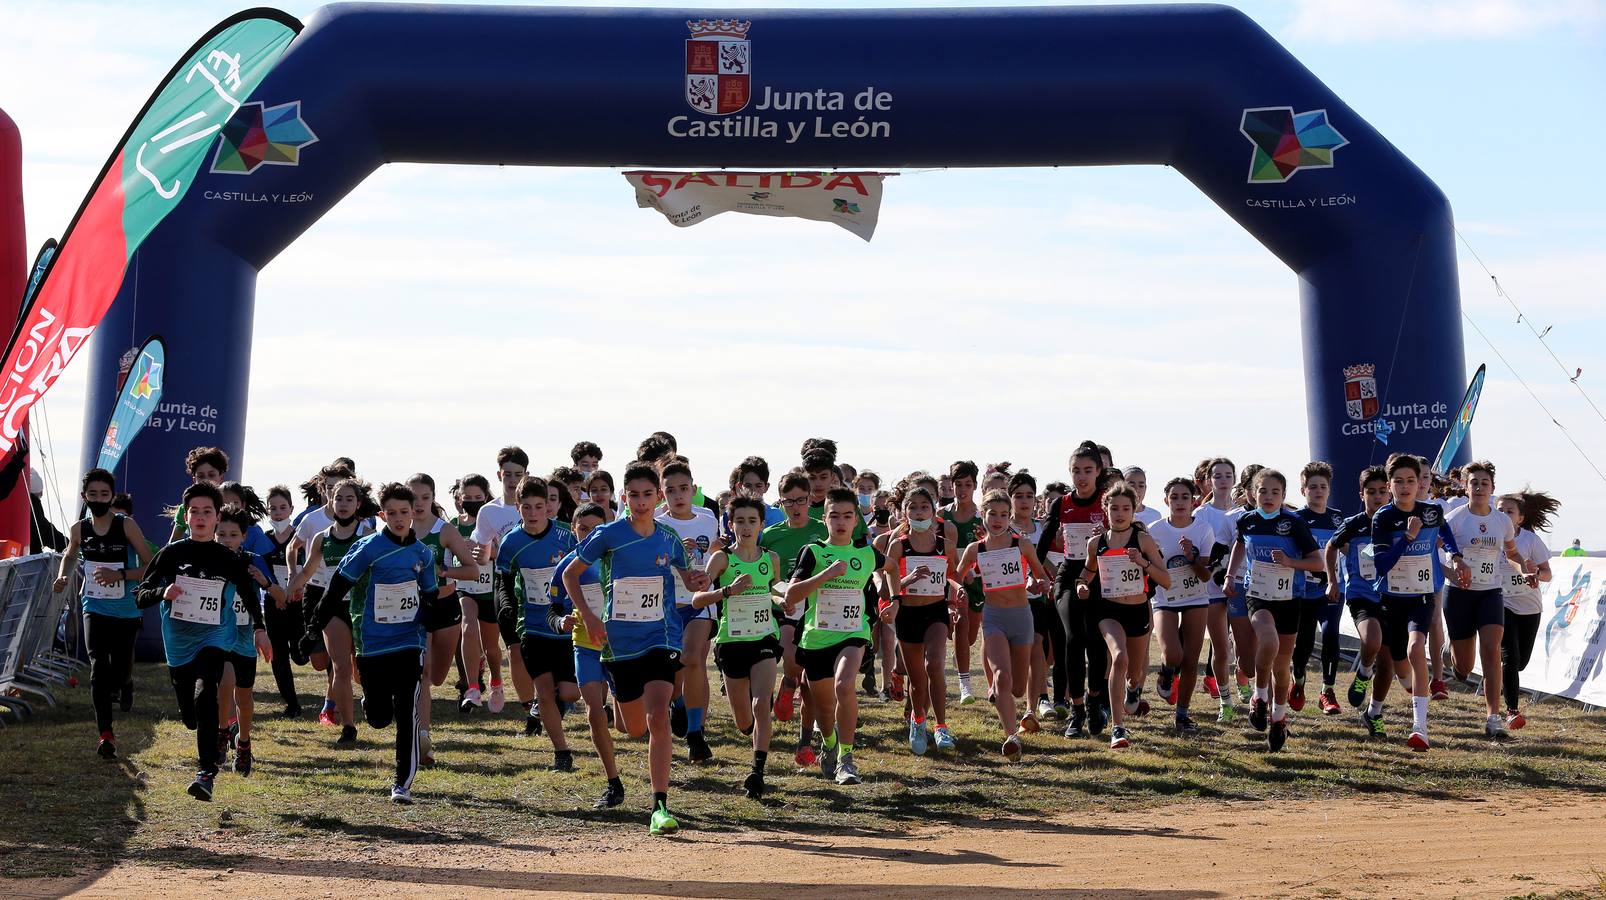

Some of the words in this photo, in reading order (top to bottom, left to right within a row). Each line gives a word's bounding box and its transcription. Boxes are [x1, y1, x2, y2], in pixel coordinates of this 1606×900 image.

[755, 86, 844, 111] Junta
[854, 86, 893, 111] de
[667, 115, 777, 138] Castilla
[785, 120, 806, 144] y
[815, 116, 891, 138] León
[204, 190, 272, 203] CASTILLA
[272, 193, 280, 202] Y
[281, 190, 314, 203] LEÓN
[1246, 198, 1306, 209] CASTILLA
[1308, 198, 1318, 207] Y
[1320, 193, 1356, 207] LEÓN
[200, 405, 218, 419] de
[1382, 402, 1427, 417] Junta
[1431, 401, 1448, 414] de
[165, 418, 176, 432] y
[180, 417, 216, 434] León
[1400, 421, 1410, 433] y
[1414, 416, 1448, 430] León
[1001, 561, 1020, 576] 364
[1120, 568, 1141, 583] 362
[1417, 568, 1430, 582] 96
[1480, 562, 1494, 574] 563
[930, 571, 945, 584] 361
[1182, 575, 1200, 590] 964
[1277, 578, 1290, 591] 91
[200, 596, 218, 611] 755
[400, 596, 418, 611] 254
[641, 592, 659, 608] 251
[754, 609, 769, 624] 553
[843, 605, 860, 619] 552
